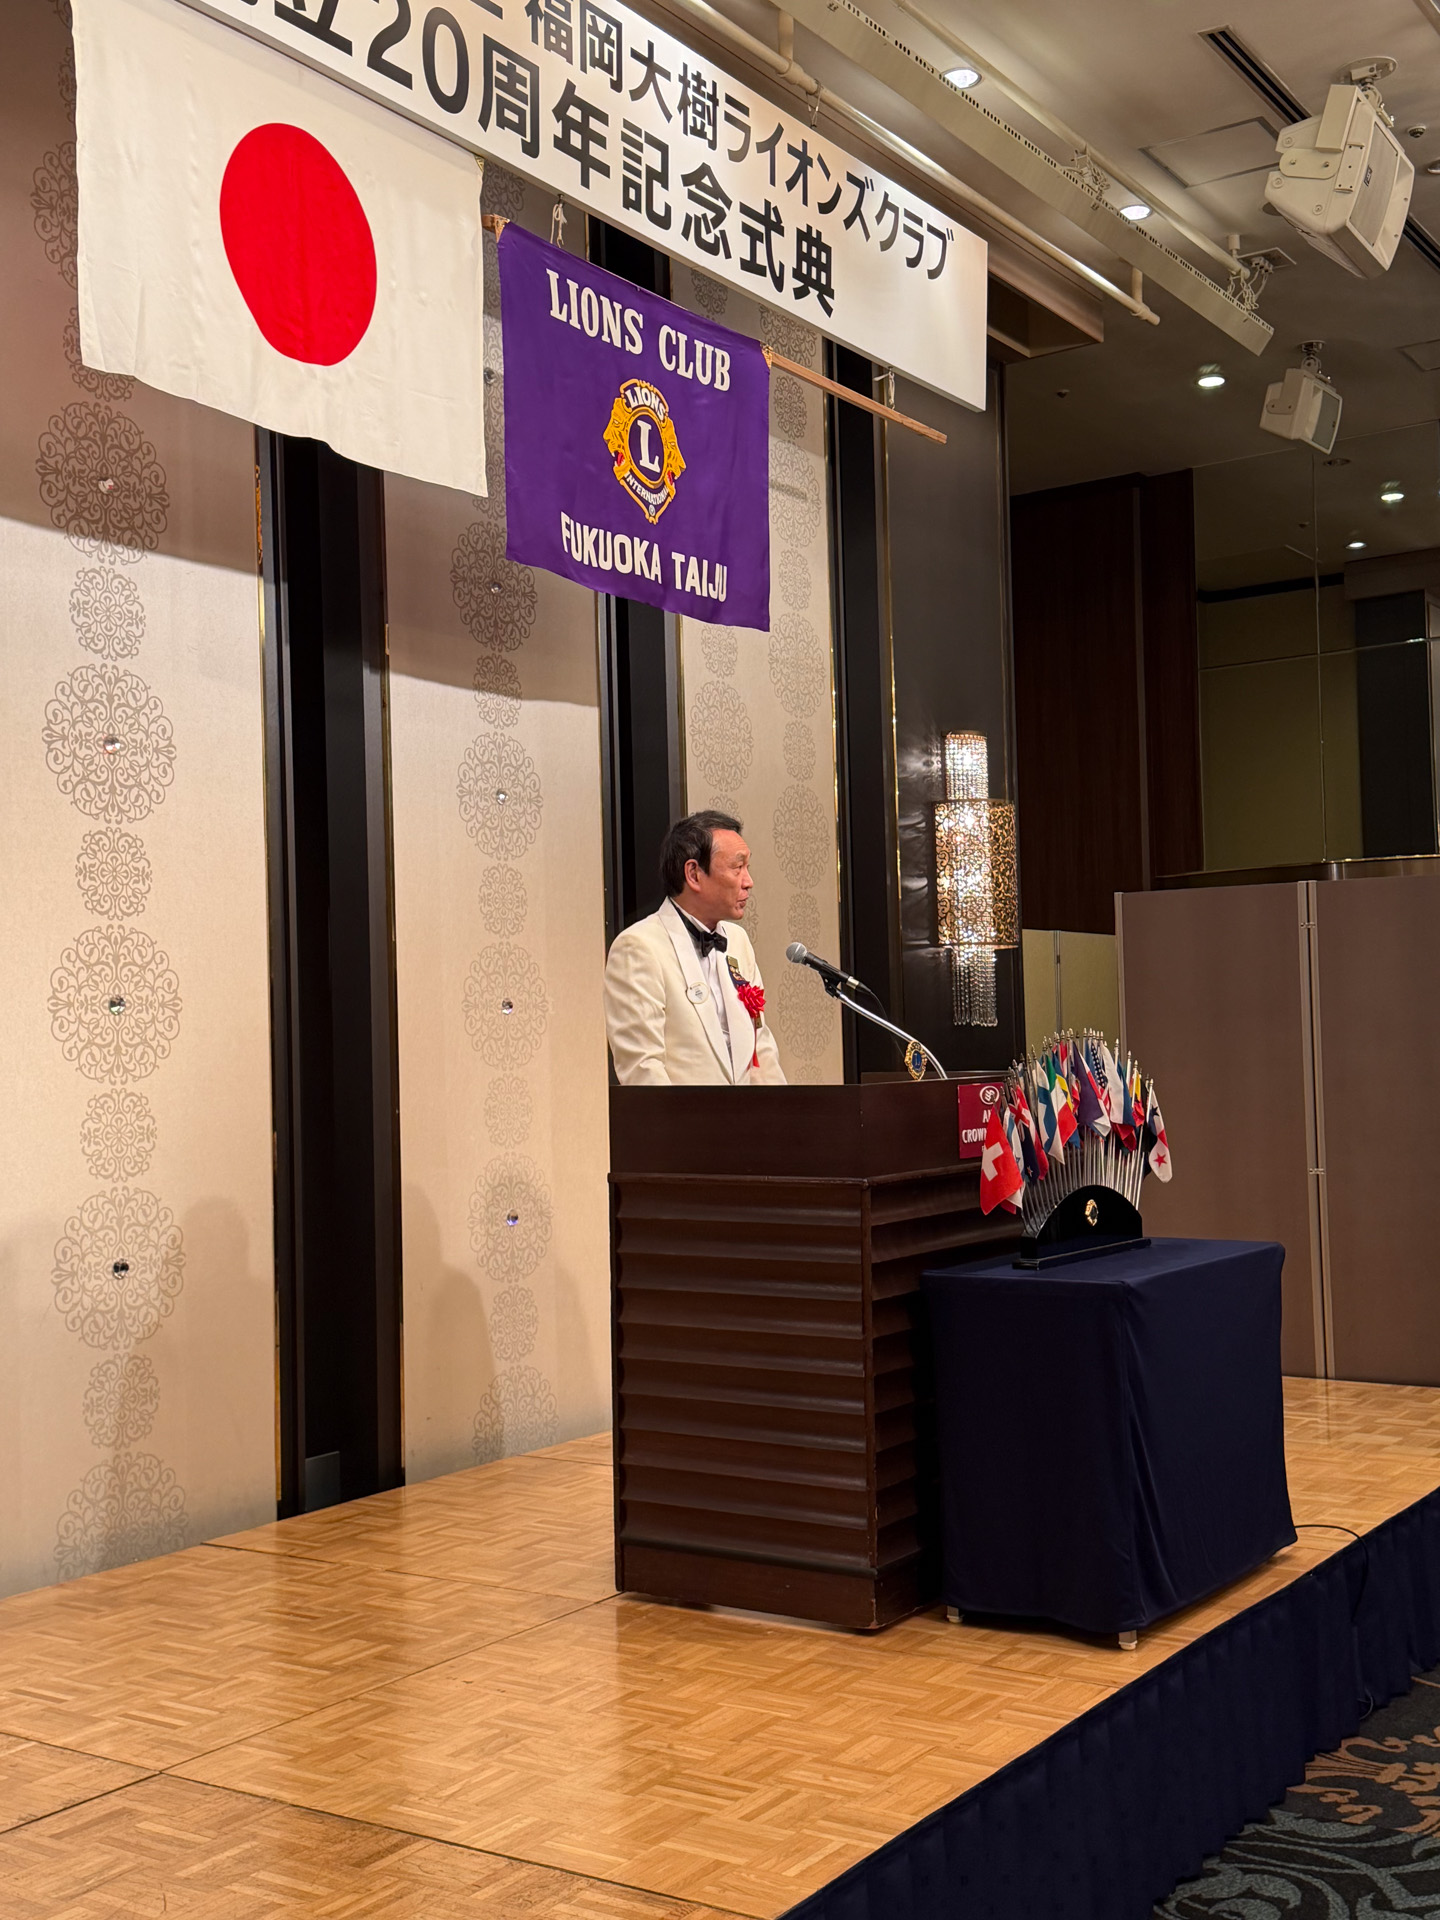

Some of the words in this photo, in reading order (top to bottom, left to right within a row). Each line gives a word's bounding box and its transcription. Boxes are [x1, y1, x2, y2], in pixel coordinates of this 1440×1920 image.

[546, 268, 644, 355] LIONS
[658, 325, 731, 392] CLUB
[625, 386, 666, 421] LIONS
[637, 419, 661, 474] L
[560, 511, 662, 584] FUKUOKA
[671, 551, 727, 603] TAIJU
